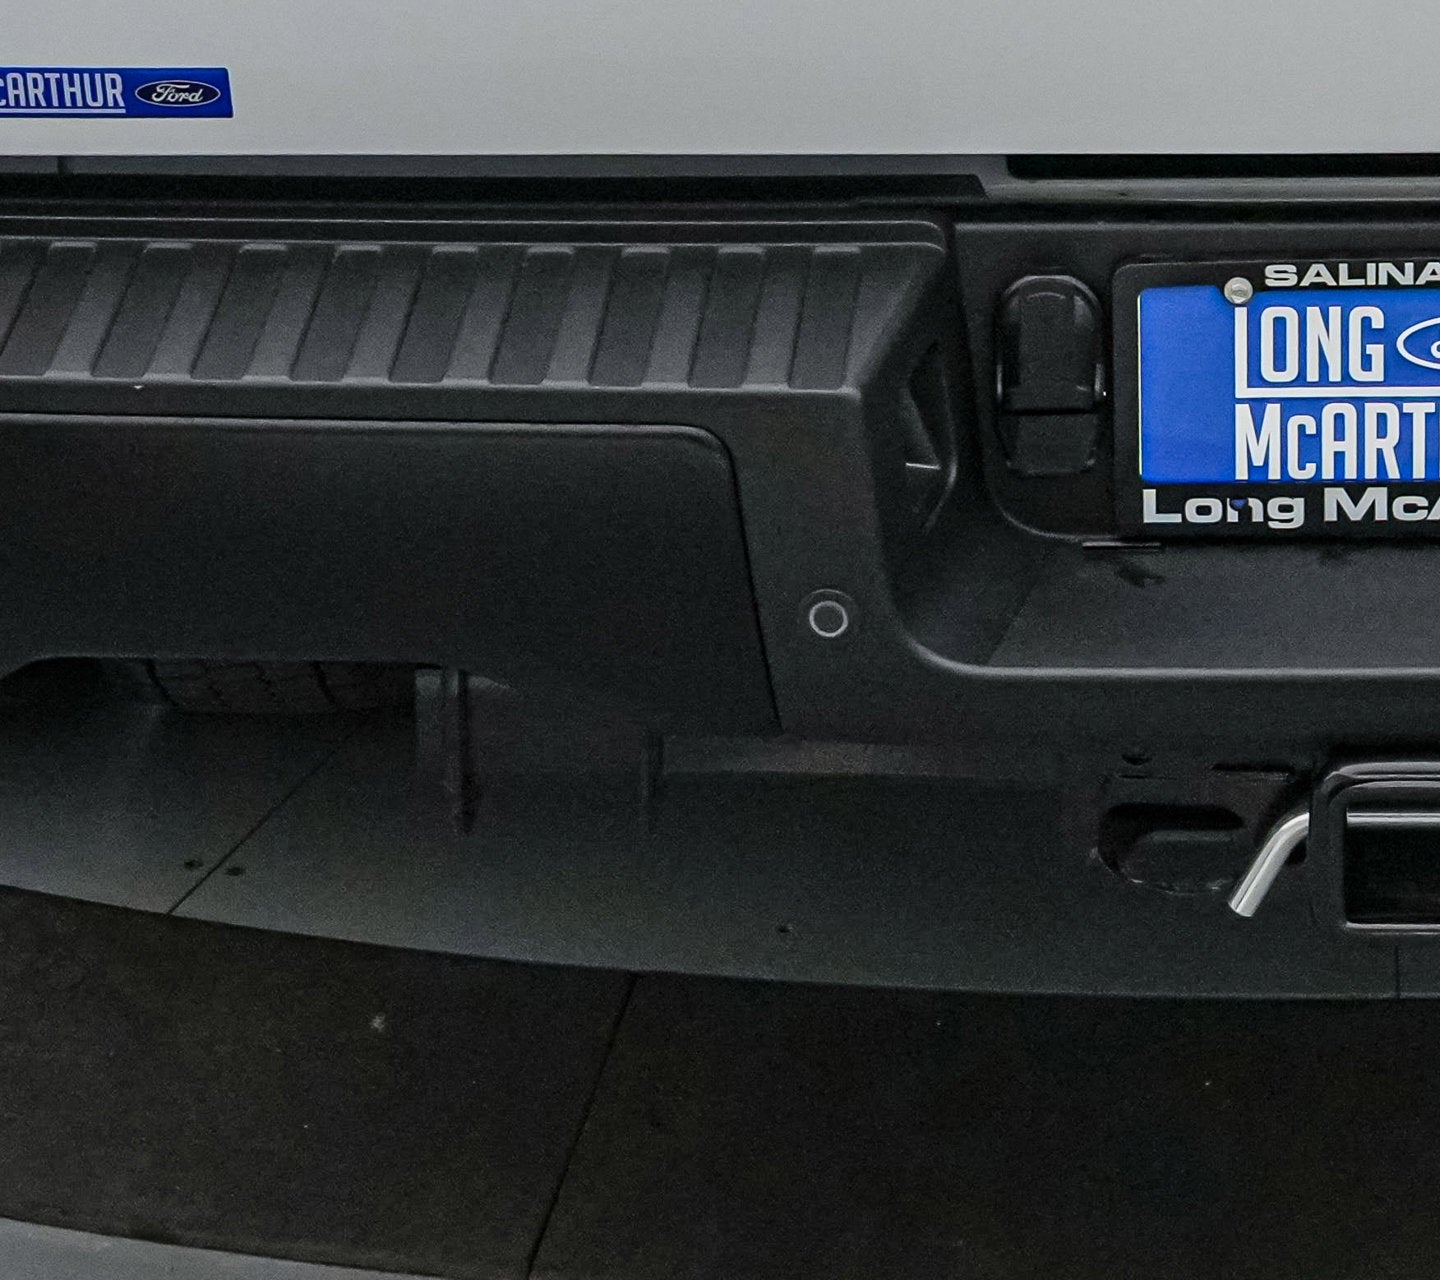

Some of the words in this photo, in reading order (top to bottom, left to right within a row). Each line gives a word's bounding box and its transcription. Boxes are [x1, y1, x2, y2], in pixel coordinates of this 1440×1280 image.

[150, 83, 204, 105] Ford
[1234, 305, 1386, 398] LONG
[1142, 488, 1306, 530] Long
